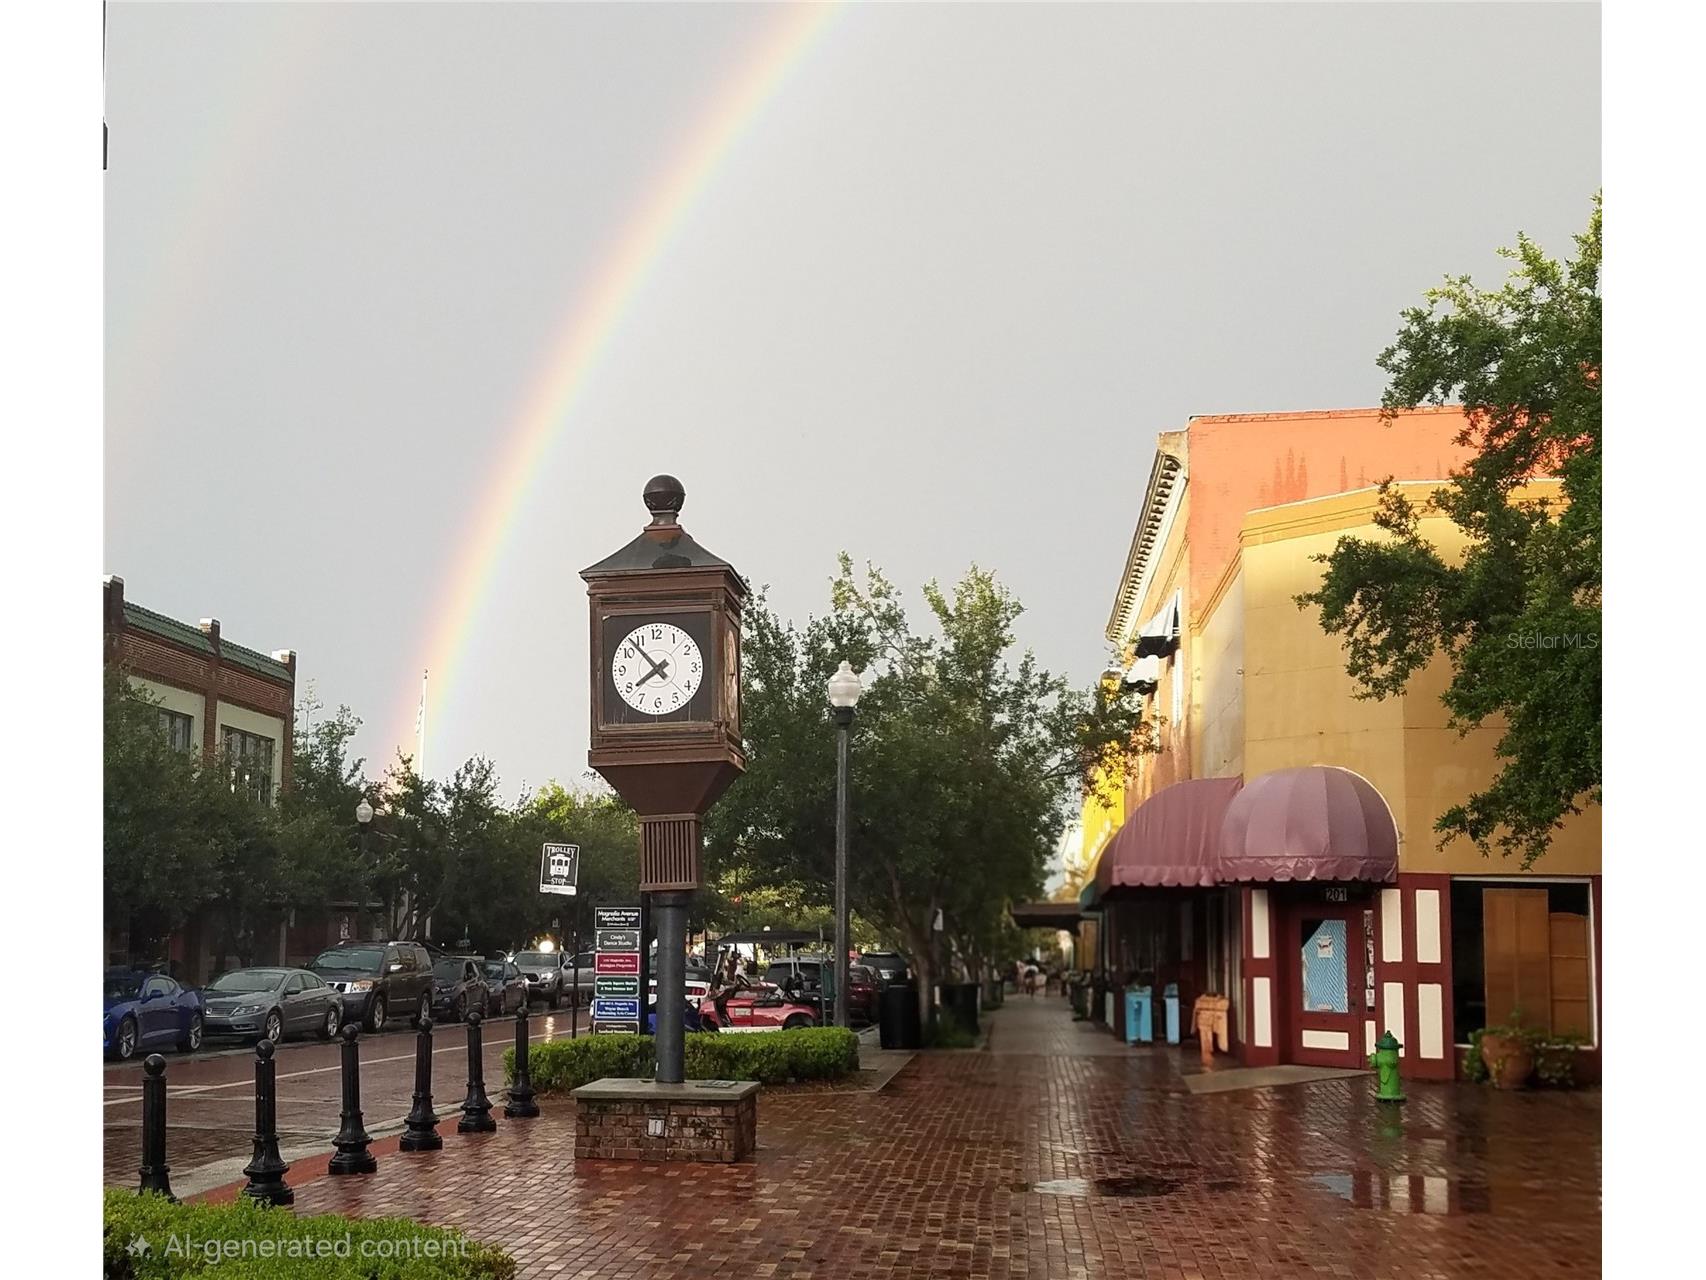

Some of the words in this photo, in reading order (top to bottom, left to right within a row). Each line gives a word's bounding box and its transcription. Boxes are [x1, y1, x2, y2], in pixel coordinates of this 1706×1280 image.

[651, 628, 662, 640] 12
[672, 632, 676, 644] 1
[636, 635, 645, 647] 11
[623, 647, 635, 659] 10
[683, 644, 691, 656] 2
[618, 665, 626, 676] 9
[690, 661, 698, 673] 3
[625, 682, 633, 694] 8
[684, 680, 691, 691] 4
[637, 693, 645, 705] 7
[654, 697, 662, 709] 6
[671, 692, 679, 704] 5
[546, 846, 576, 858] TROLLEY
[551, 878, 567, 886] STOP
[1327, 888, 1346, 901] 201
